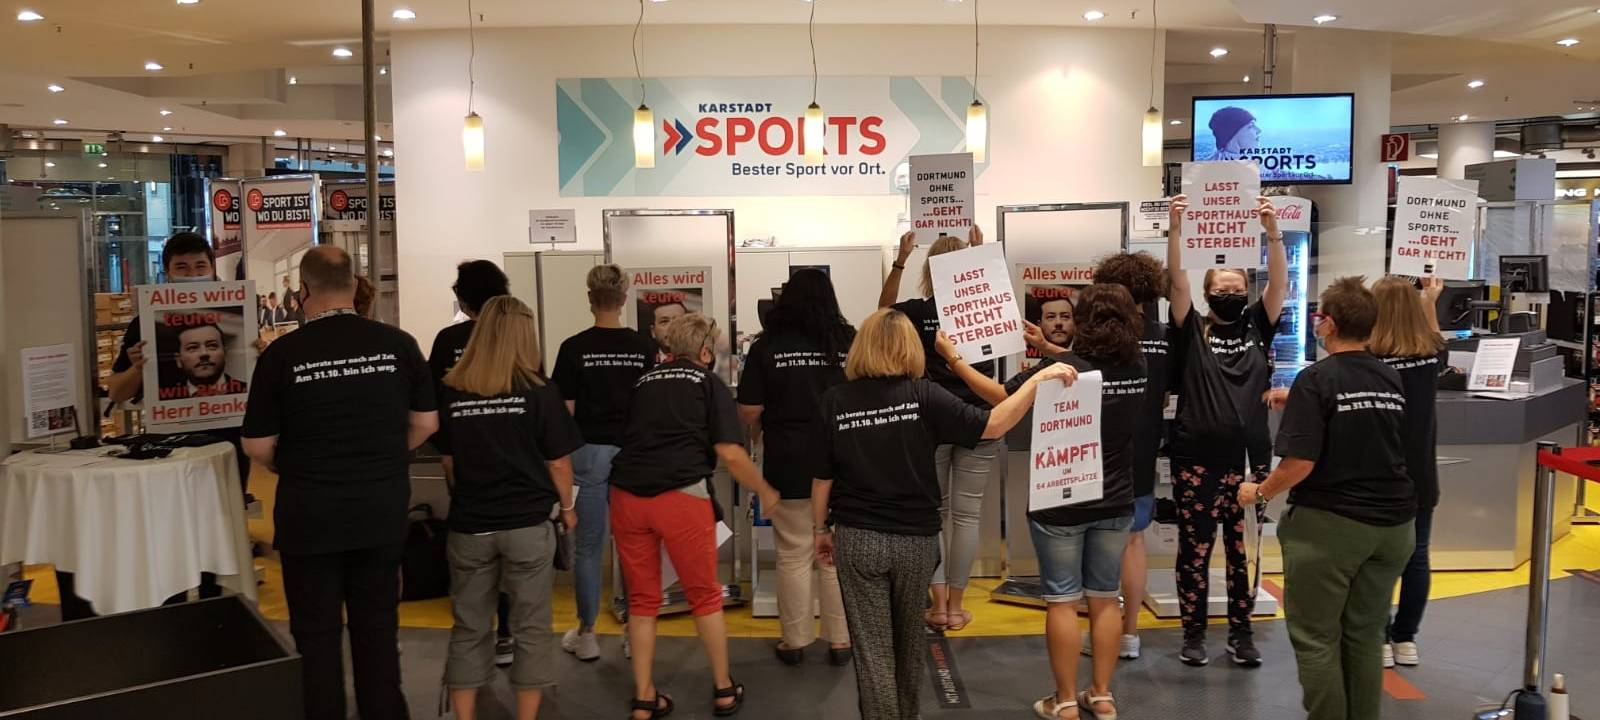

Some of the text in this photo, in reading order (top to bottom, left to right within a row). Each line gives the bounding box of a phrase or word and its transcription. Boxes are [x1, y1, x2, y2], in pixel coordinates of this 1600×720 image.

[698, 103, 773, 113] KARSTADT
[1239, 147, 1292, 155] KARSTADT
[731, 162, 886, 178] Bester Sport vor Ort.
[917, 171, 966, 181] DORTMUND
[929, 184, 954, 192] OHNE
[1205, 182, 1240, 192] LASST
[263, 195, 309, 209] SPORT IST
[921, 196, 964, 204] SPORTS...
[1203, 196, 1241, 205] UNSER
[1407, 197, 1466, 208] DORTMUND
[257, 209, 311, 222] WO DU BIST!
[923, 206, 963, 216] ...GEHT
[1187, 210, 1258, 220] SPORTHAUS
[1420, 211, 1450, 220] OHNE
[915, 218, 972, 228] GAR NICHT!
[1197, 222, 1247, 234] NICHT
[1408, 223, 1459, 234] SPORTS...
[1186, 237, 1256, 248] STERBEN!
[1408, 235, 1457, 246] ...GEHT
[1398, 247, 1420, 257] GAR
[633, 271, 704, 285] Alles wird
[953, 268, 985, 283] LASST
[1023, 267, 1094, 280] Alles wird
[150, 286, 245, 305] Alles wird
[954, 283, 991, 299] UNSER
[1030, 286, 1073, 299] teurer
[943, 293, 1012, 316] SPORTHAUS
[163, 312, 225, 327] teurer
[954, 307, 1003, 329] NICHT
[948, 320, 1018, 345] STERBEN!
[293, 364, 306, 373] Ich
[306, 361, 331, 369] berate
[348, 356, 367, 364] noch
[368, 354, 381, 362] auf
[295, 364, 397, 384] Am 31.10. bin ich weg.
[160, 383, 192, 399] wir
[152, 404, 193, 420] Herr
[845, 410, 866, 418] berate
[878, 405, 894, 413] noch
[894, 403, 905, 411] auf
[1054, 400, 1079, 413] TEAM
[838, 413, 920, 431] Am 31.10. bin ich weg.
[1040, 415, 1093, 433] DORTMUND
[1035, 442, 1099, 470] KÄMPFT
[1063, 467, 1072, 475] UM
